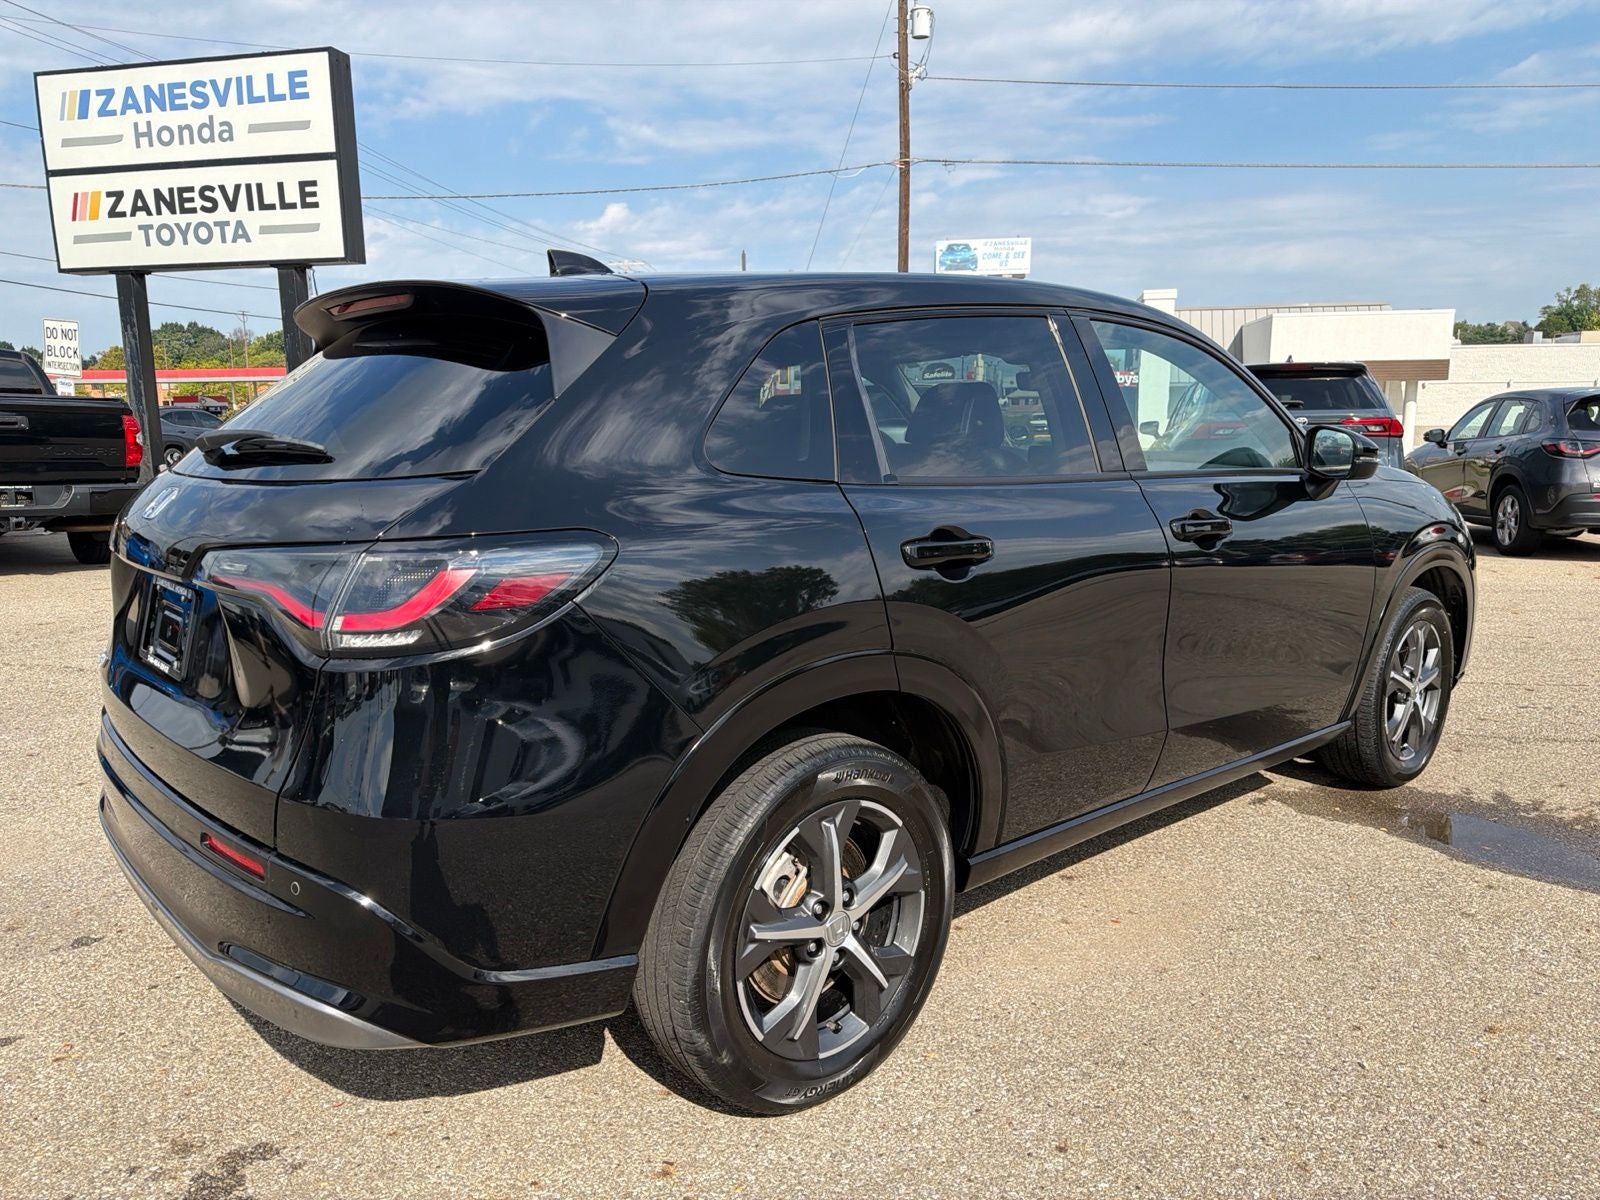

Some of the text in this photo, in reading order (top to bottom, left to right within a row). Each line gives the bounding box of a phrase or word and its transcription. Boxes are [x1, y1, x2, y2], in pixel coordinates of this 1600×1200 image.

[95, 69, 310, 118] ZANESVILLE
[133, 115, 234, 149] Honda
[105, 180, 320, 219] ZANESVILLE
[137, 219, 252, 247] TOYOTA
[982, 252, 1003, 260] COME
[1013, 251, 1026, 259] SEE
[45, 326, 77, 341] DO NOT
[47, 344, 79, 359] BLOCK
[45, 360, 80, 371] INTERSECTION
